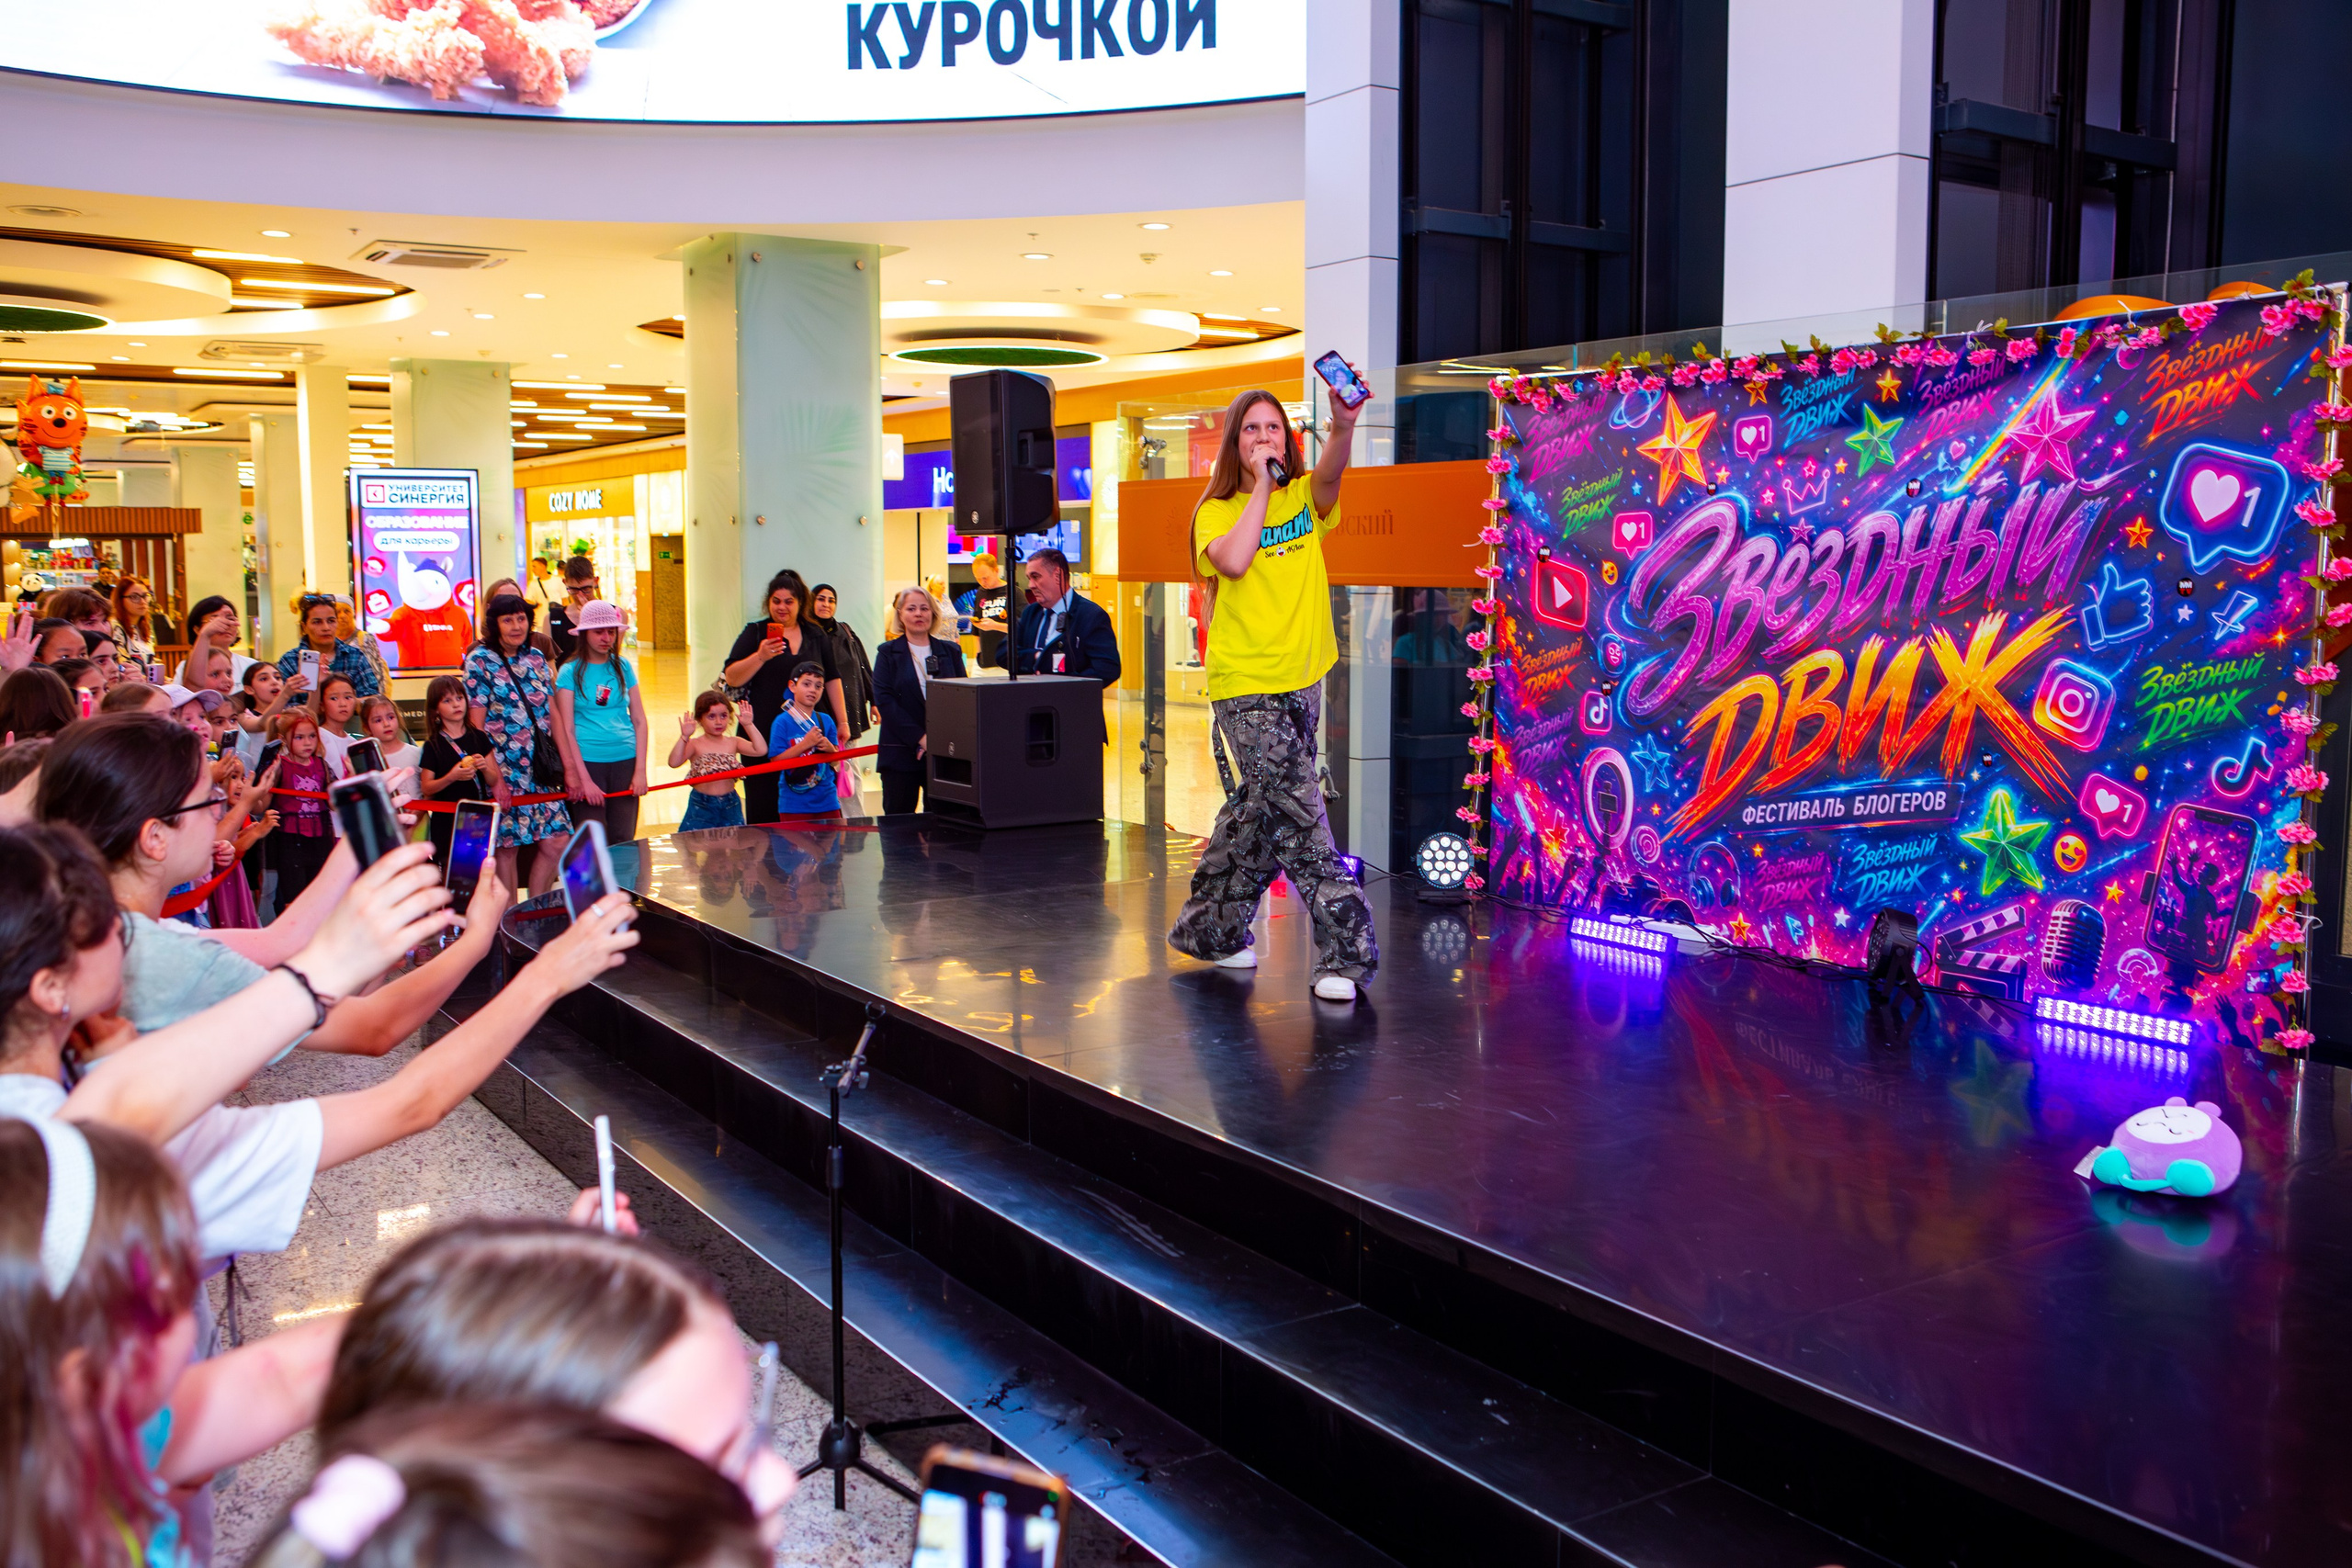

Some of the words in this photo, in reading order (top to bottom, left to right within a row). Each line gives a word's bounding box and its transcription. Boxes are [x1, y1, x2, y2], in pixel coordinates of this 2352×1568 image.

[389, 484, 464, 492] УНИВЕРСИТЕТ
[389, 493, 464, 503] СИНЕРГИЯ
[548, 492, 573, 513] COZY
[575, 489, 603, 511] HOME
[1257, 502, 1314, 550] anana
[380, 537, 402, 546] для
[405, 537, 453, 547] карьеры
[1742, 797, 1846, 825] ФЕСТИВАЛЬ
[1853, 791, 1947, 816] БЛОГЕРОВ
